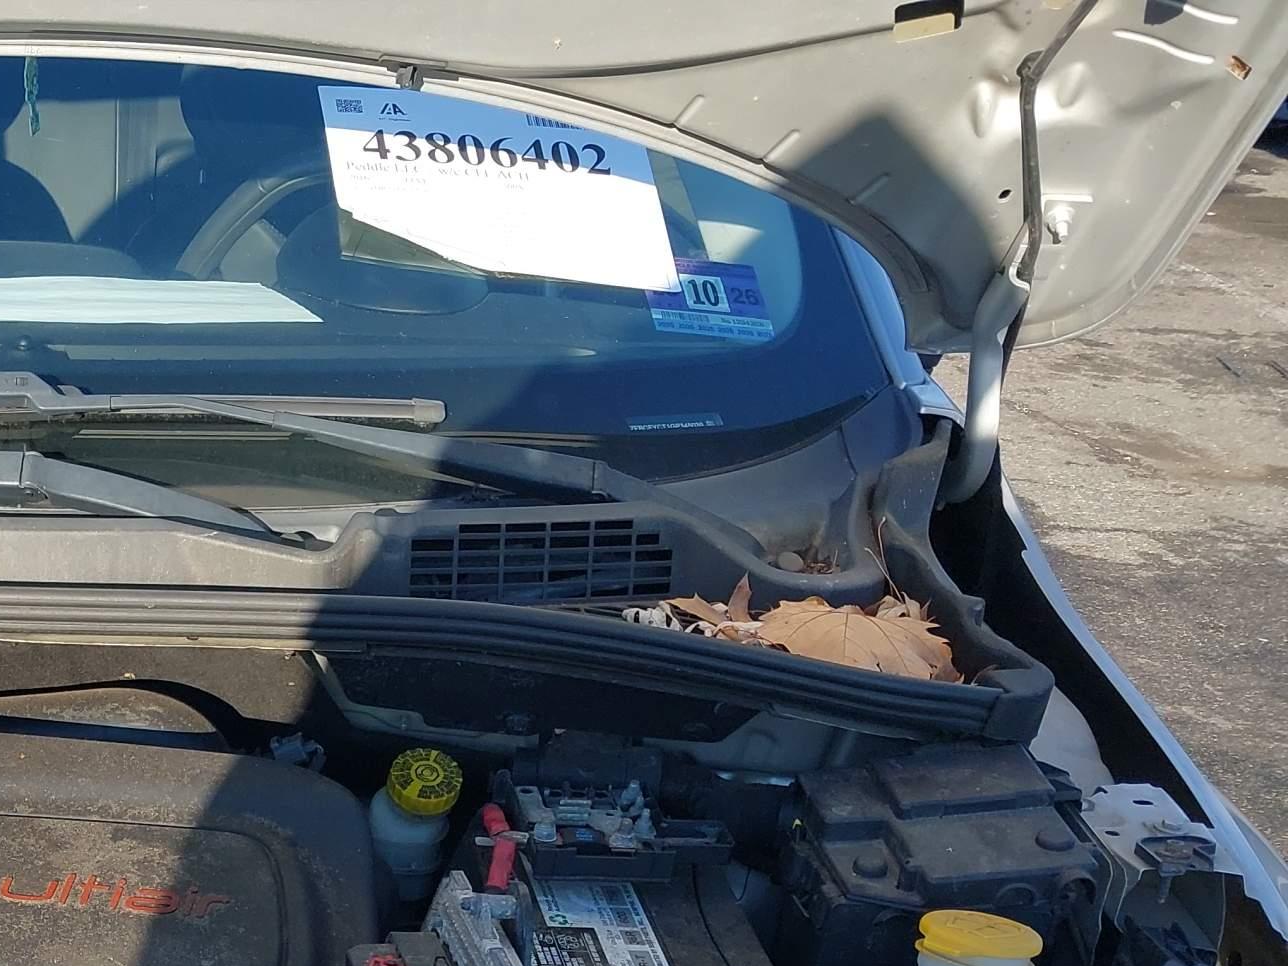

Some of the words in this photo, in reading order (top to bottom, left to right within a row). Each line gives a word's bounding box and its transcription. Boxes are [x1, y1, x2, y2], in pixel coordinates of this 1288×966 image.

[362, 128, 612, 176] 43806402
[687, 279, 720, 307] 10
[730, 287, 760, 306] 26
